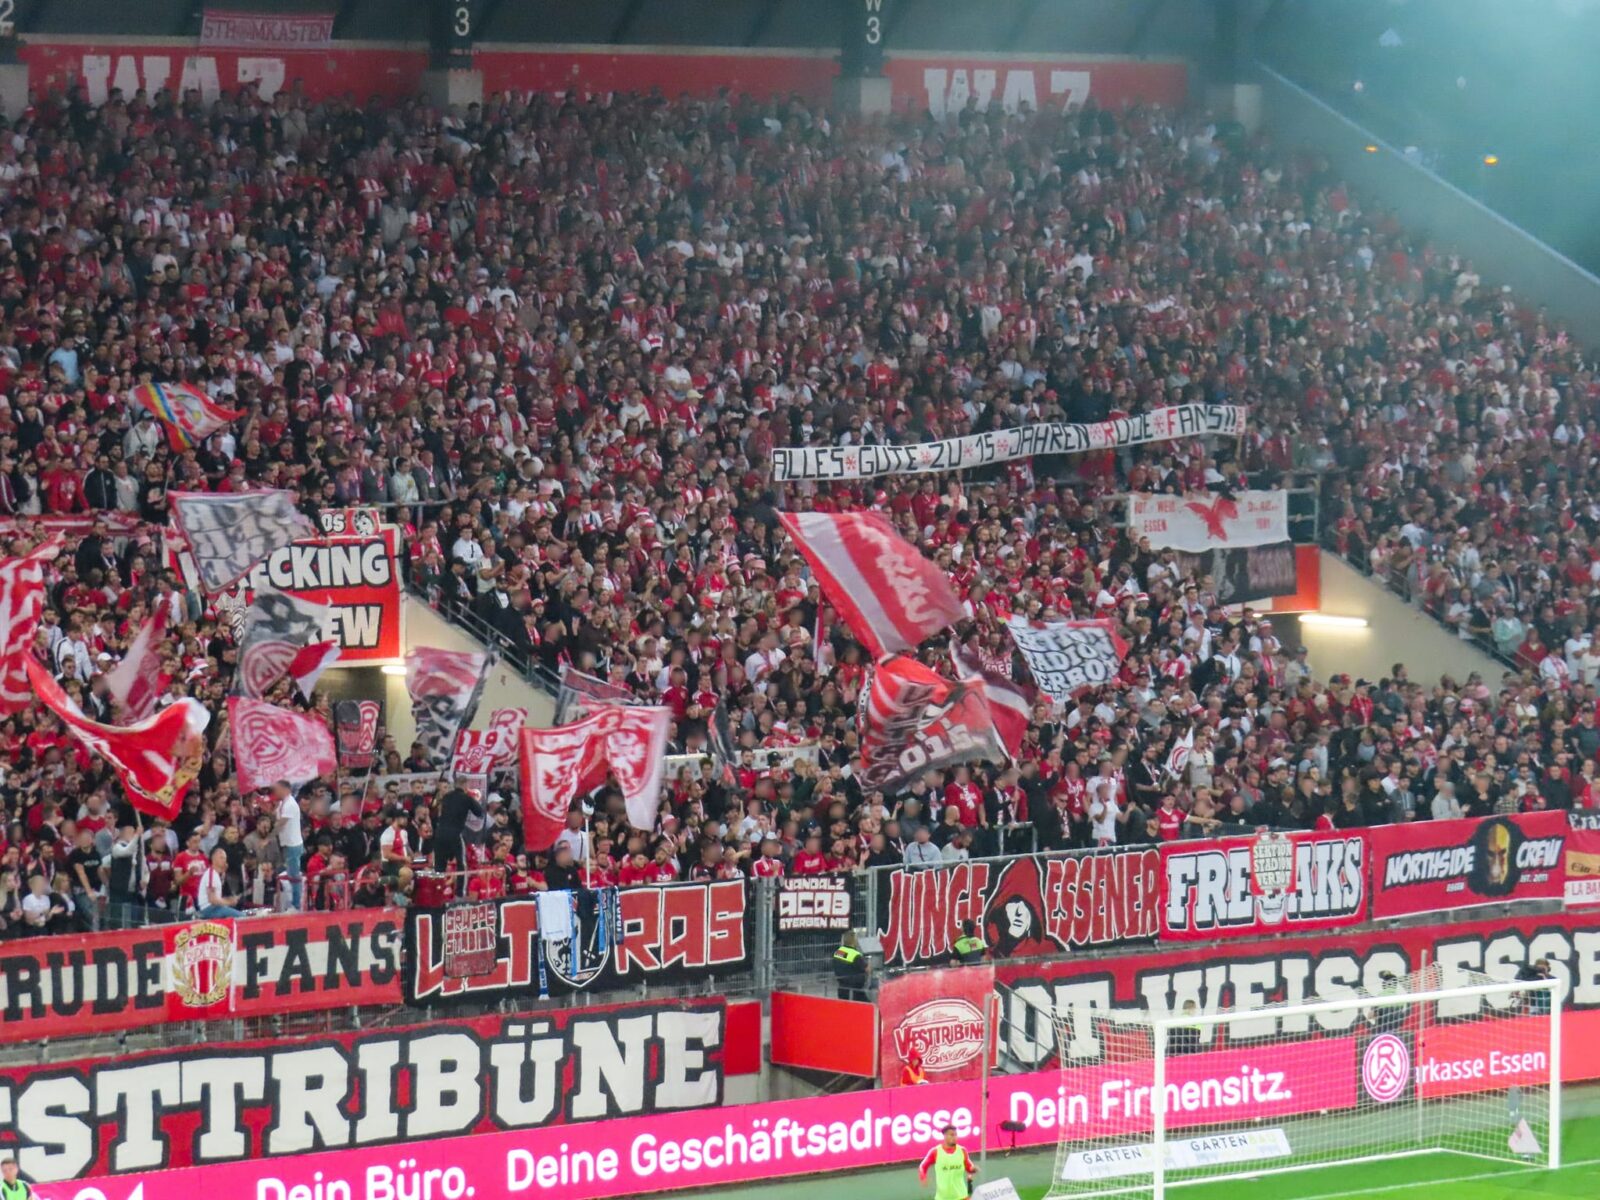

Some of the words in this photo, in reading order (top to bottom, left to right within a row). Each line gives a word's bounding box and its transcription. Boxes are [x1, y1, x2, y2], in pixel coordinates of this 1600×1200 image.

[454, 7, 470, 36] 3
[866, 16, 881, 44] 3
[773, 448, 844, 480] ALLES
[859, 445, 918, 476] GUTE
[928, 439, 963, 469] ZU
[975, 433, 996, 463] 15
[1008, 423, 1090, 457] JAHREN
[1167, 838, 1363, 930] FREAKS
[1384, 845, 1476, 887] NORTHSIDE
[1515, 838, 1564, 869] CREW
[779, 892, 850, 916] ACAB
[829, 917, 849, 928] NIE
[879, 863, 990, 964] JUNGE
[1045, 850, 1160, 945] ESSENER
[2, 940, 165, 1022] RUDE
[242, 920, 397, 1000] FANS
[992, 950, 1407, 1064] OT-WEISS
[1489, 1051, 1546, 1076] Essen
[366, 1158, 476, 1200] Büro.
[507, 1143, 618, 1192] Deine
[630, 1106, 981, 1177] Geschäftsadresse.
[1009, 1087, 1089, 1128] Dein
